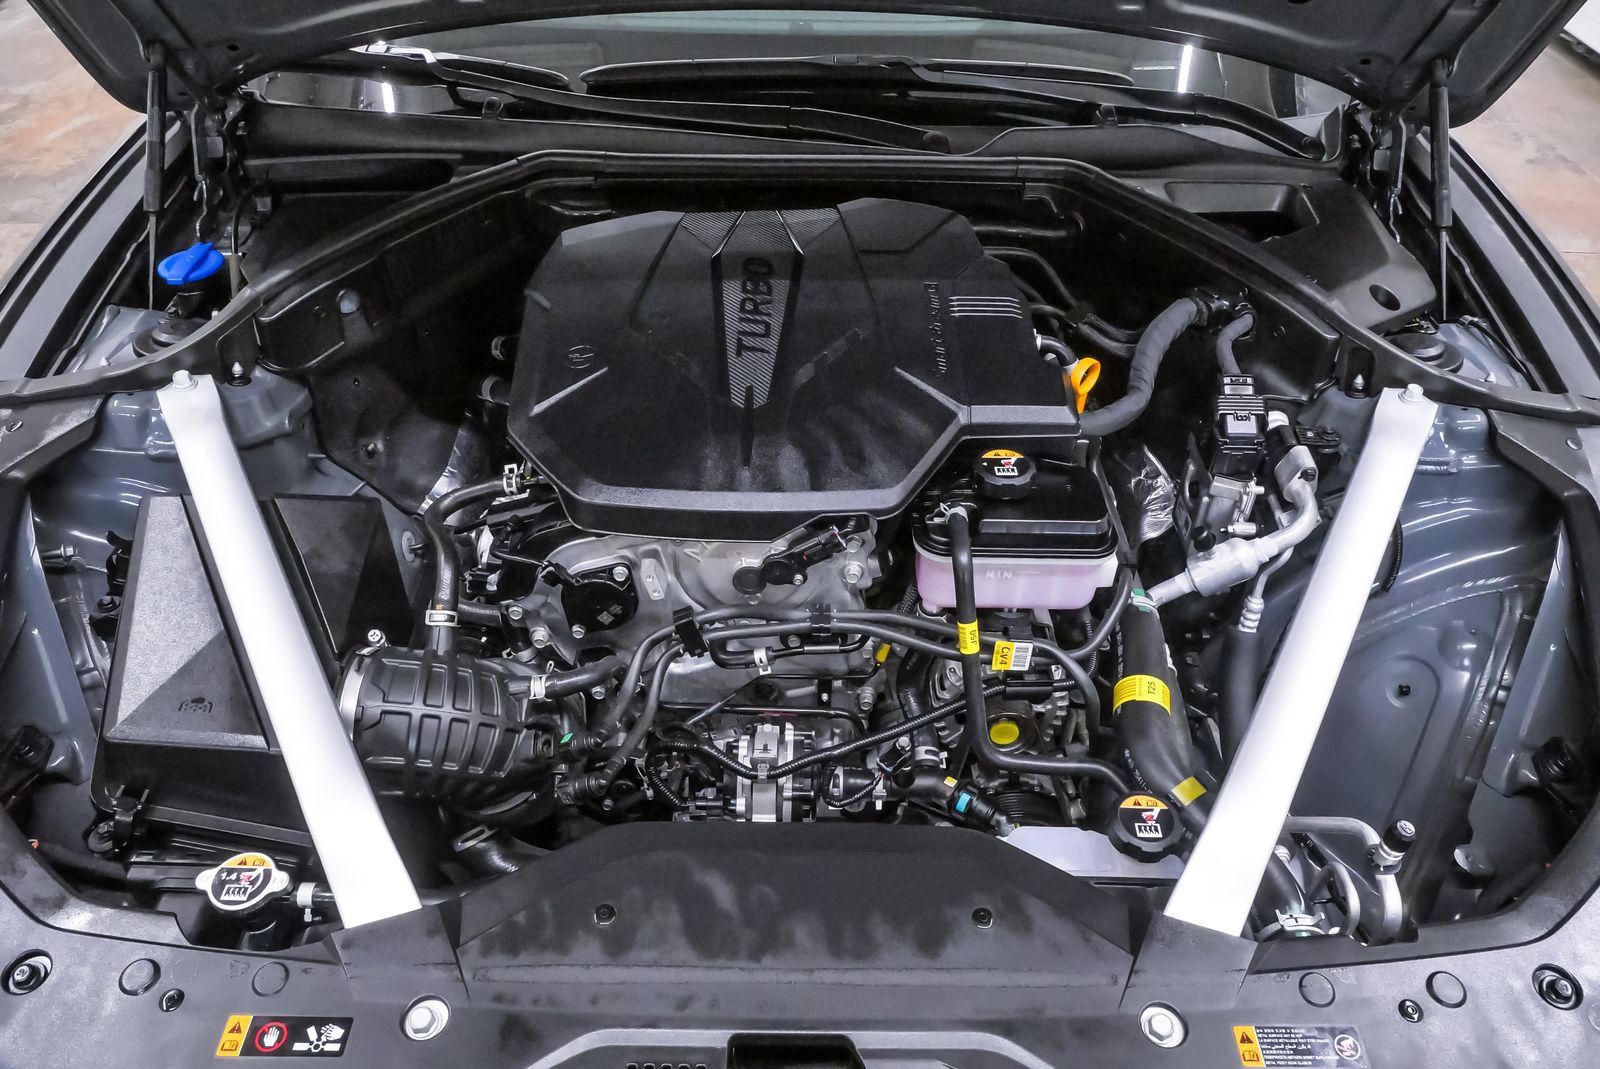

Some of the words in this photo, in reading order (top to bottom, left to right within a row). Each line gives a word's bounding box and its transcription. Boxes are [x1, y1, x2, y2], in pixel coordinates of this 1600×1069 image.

[736, 257, 775, 358] TURBO
[985, 570, 1013, 580] MIN
[999, 646, 1011, 665] CV4
[1147, 680, 1156, 695] T25
